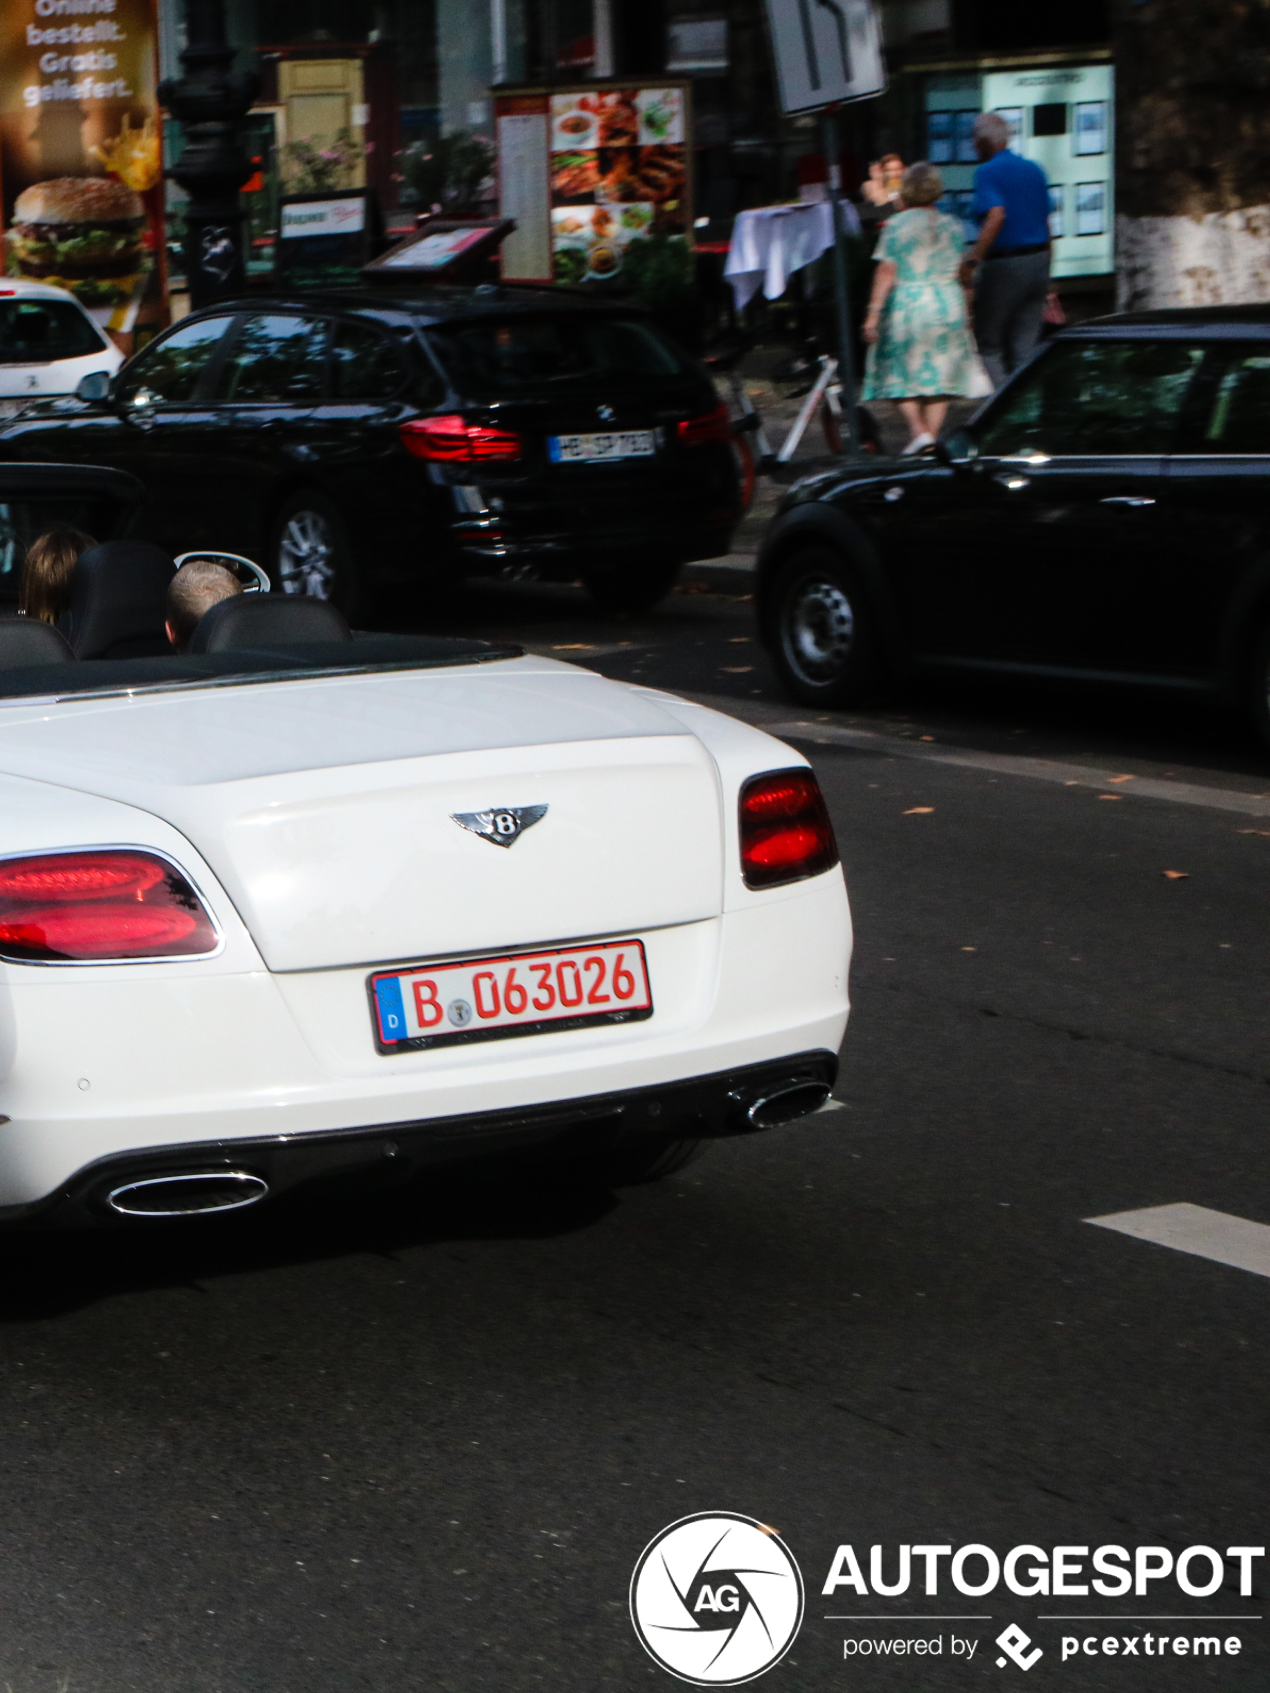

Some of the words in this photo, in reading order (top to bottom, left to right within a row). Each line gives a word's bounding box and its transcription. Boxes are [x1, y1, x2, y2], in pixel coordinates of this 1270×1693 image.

[36, 0, 116, 16] Online
[27, 20, 126, 45] bestellt.
[40, 49, 117, 73] Gratis
[24, 77, 133, 108] geliefert.
[388, 1014, 399, 1029] D
[412, 979, 444, 1028] B
[472, 953, 636, 1019] 063026
